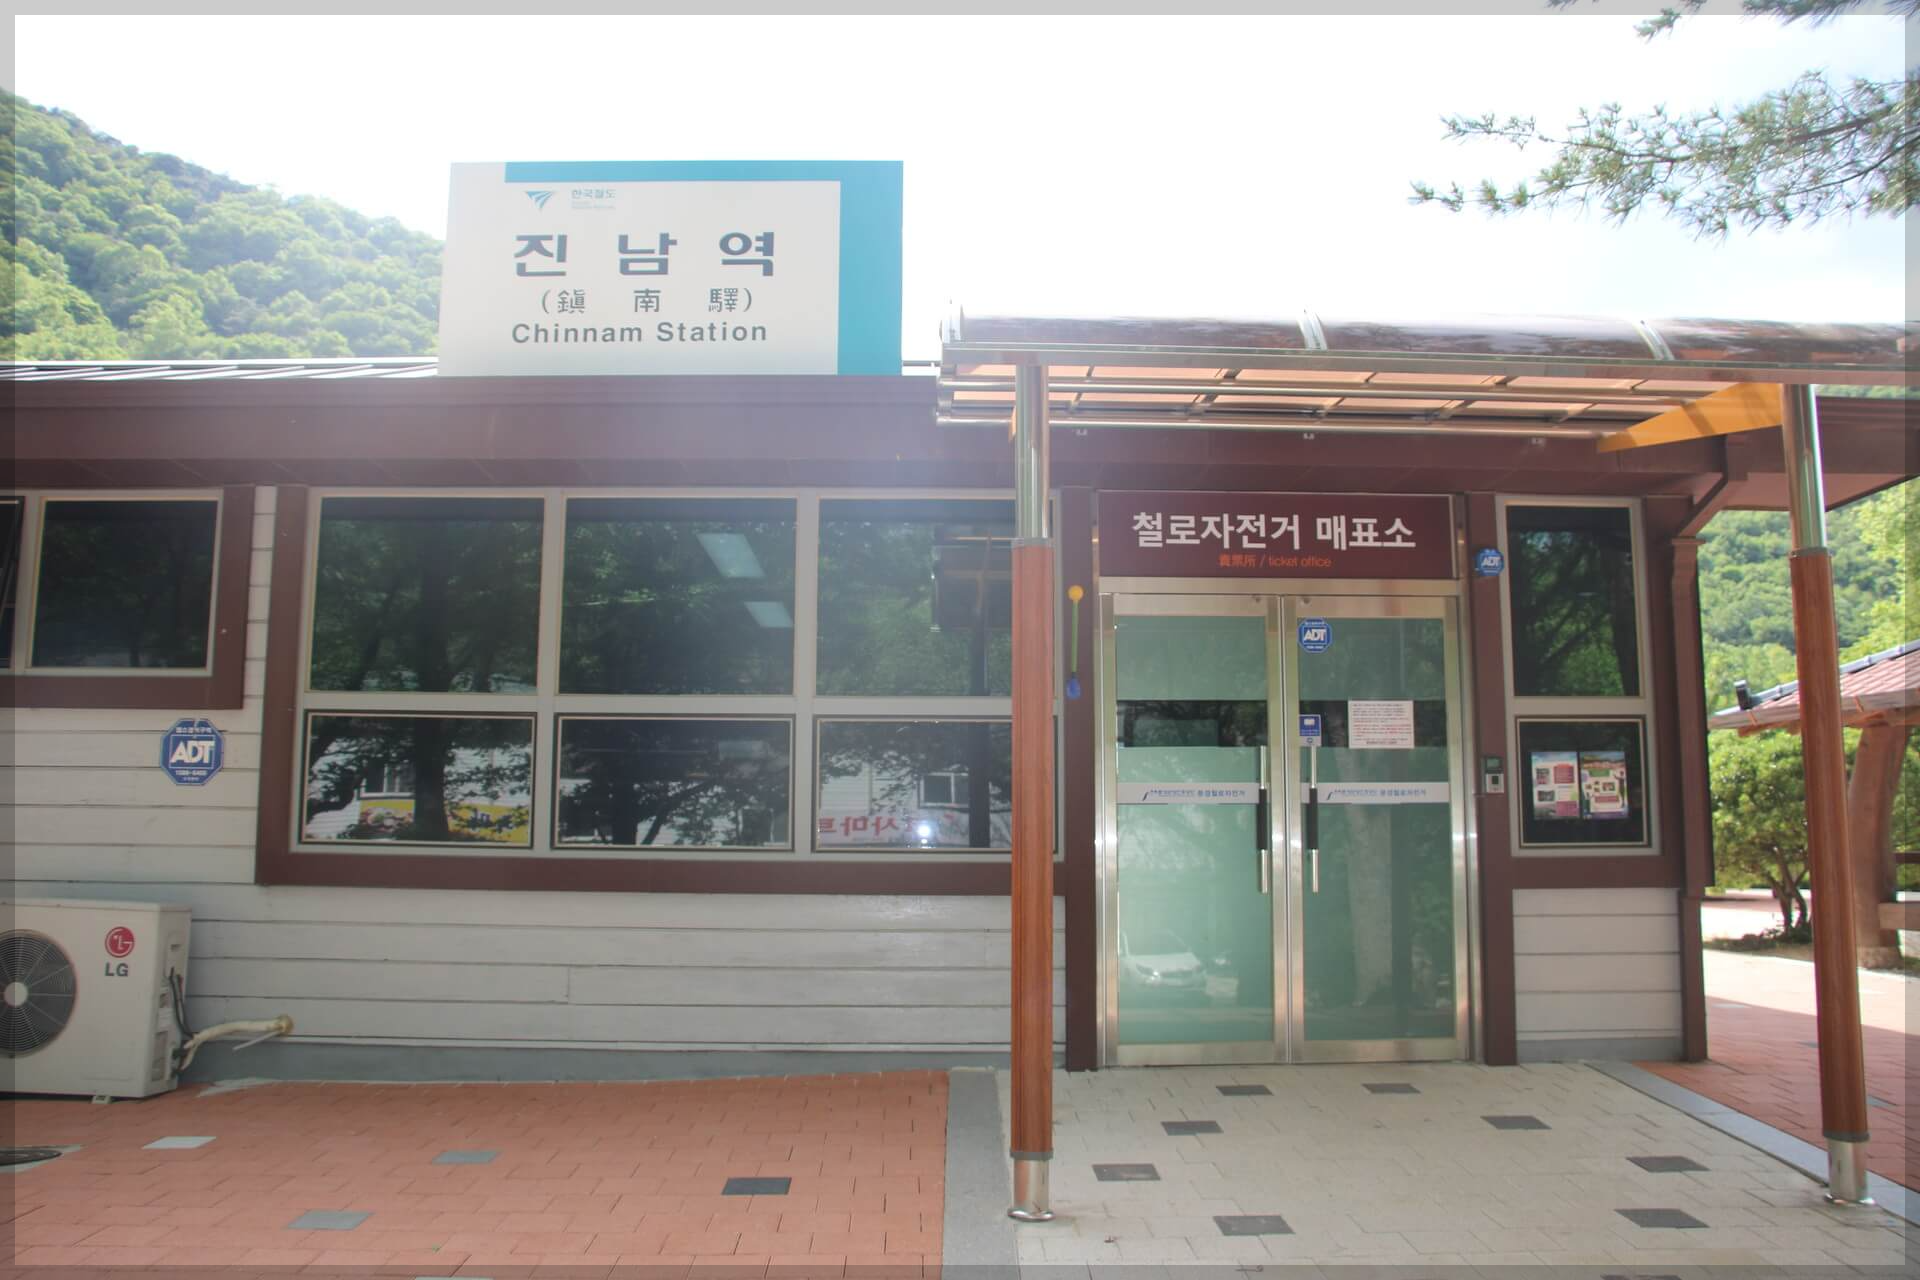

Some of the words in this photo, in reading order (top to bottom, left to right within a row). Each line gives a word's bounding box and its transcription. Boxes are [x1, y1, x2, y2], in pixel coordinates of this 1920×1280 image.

[513, 231, 775, 277] 진남역
[512, 322, 643, 344] Chinnam
[656, 321, 768, 342] Station
[1132, 511, 1300, 550] 철로자전거
[1315, 514, 1416, 551] 매표소
[1268, 553, 1298, 568] ticket
[1300, 554, 1332, 568] office
[1480, 556, 1501, 567] ADT
[1303, 628, 1327, 641] ADT
[170, 740, 216, 764] ADT
[104, 961, 129, 977] LG
